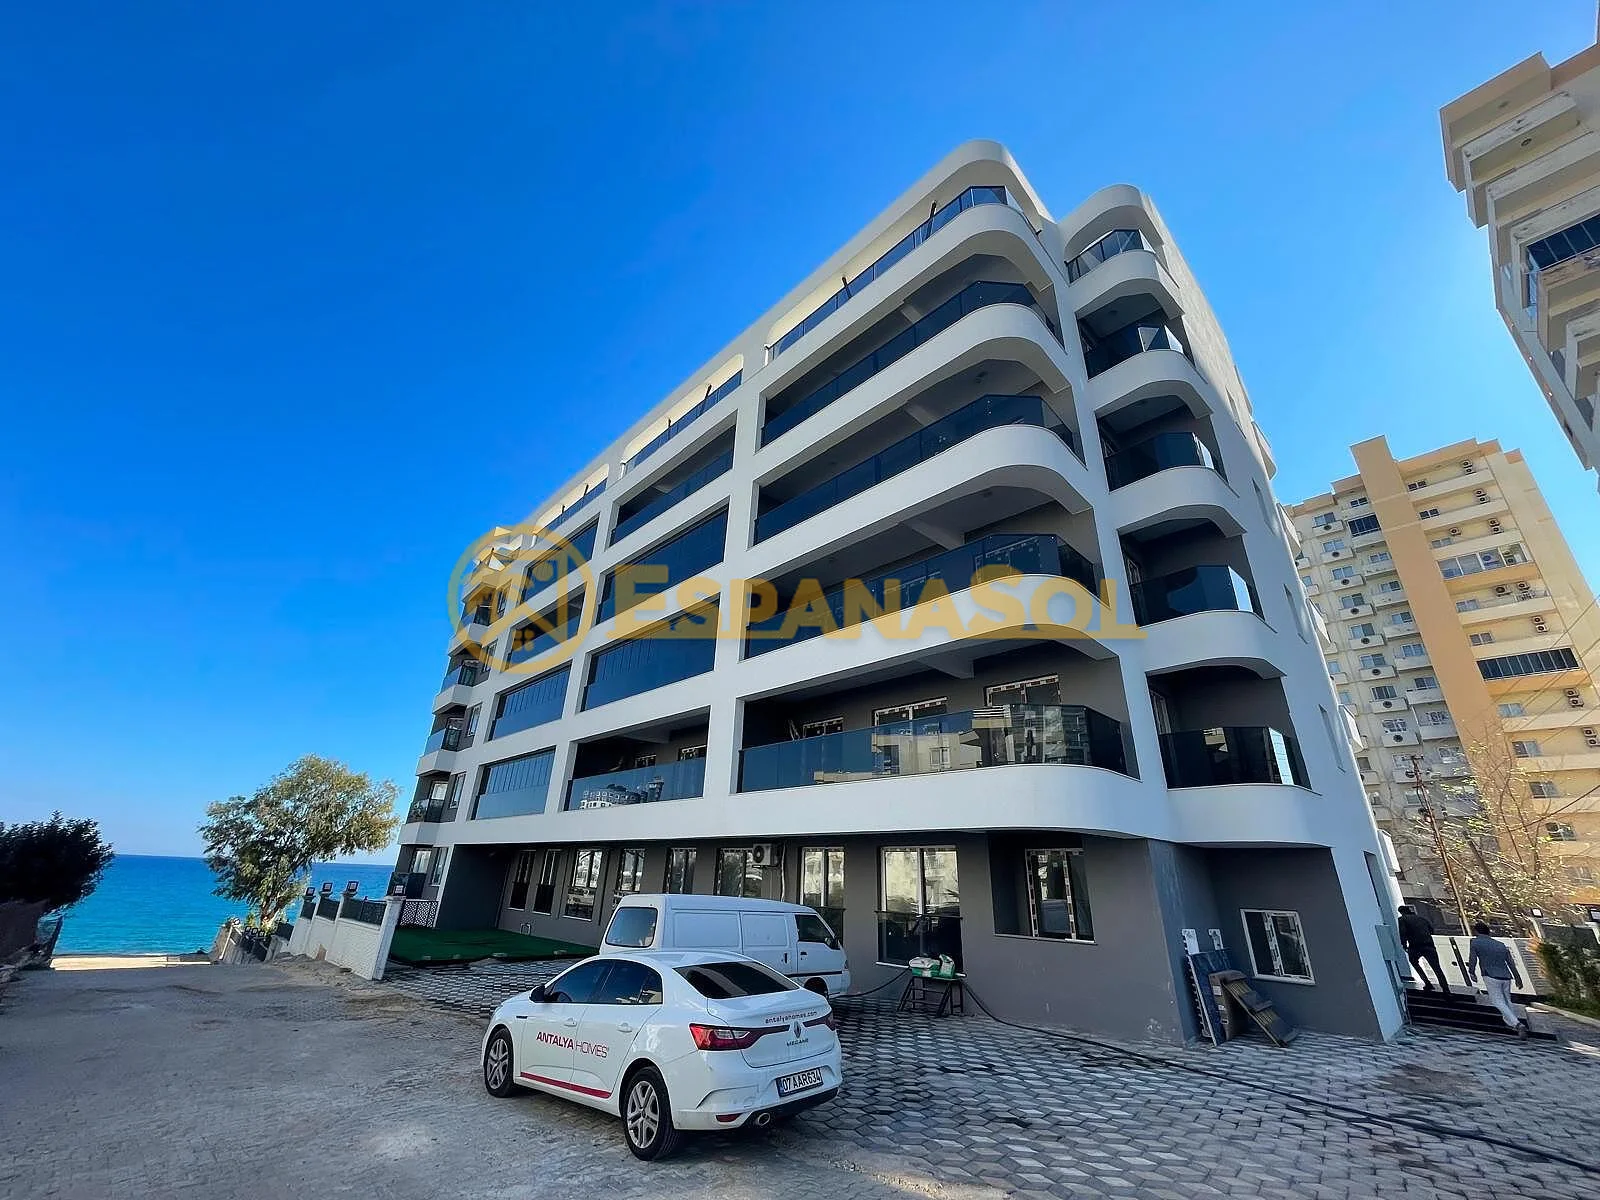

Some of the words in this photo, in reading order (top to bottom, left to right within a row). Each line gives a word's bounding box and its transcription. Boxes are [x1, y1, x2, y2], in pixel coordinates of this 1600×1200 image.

[765, 1011, 818, 1024] antalyahomes.com
[536, 1031, 574, 1050] ANTALYA
[575, 1041, 608, 1058] HOMES
